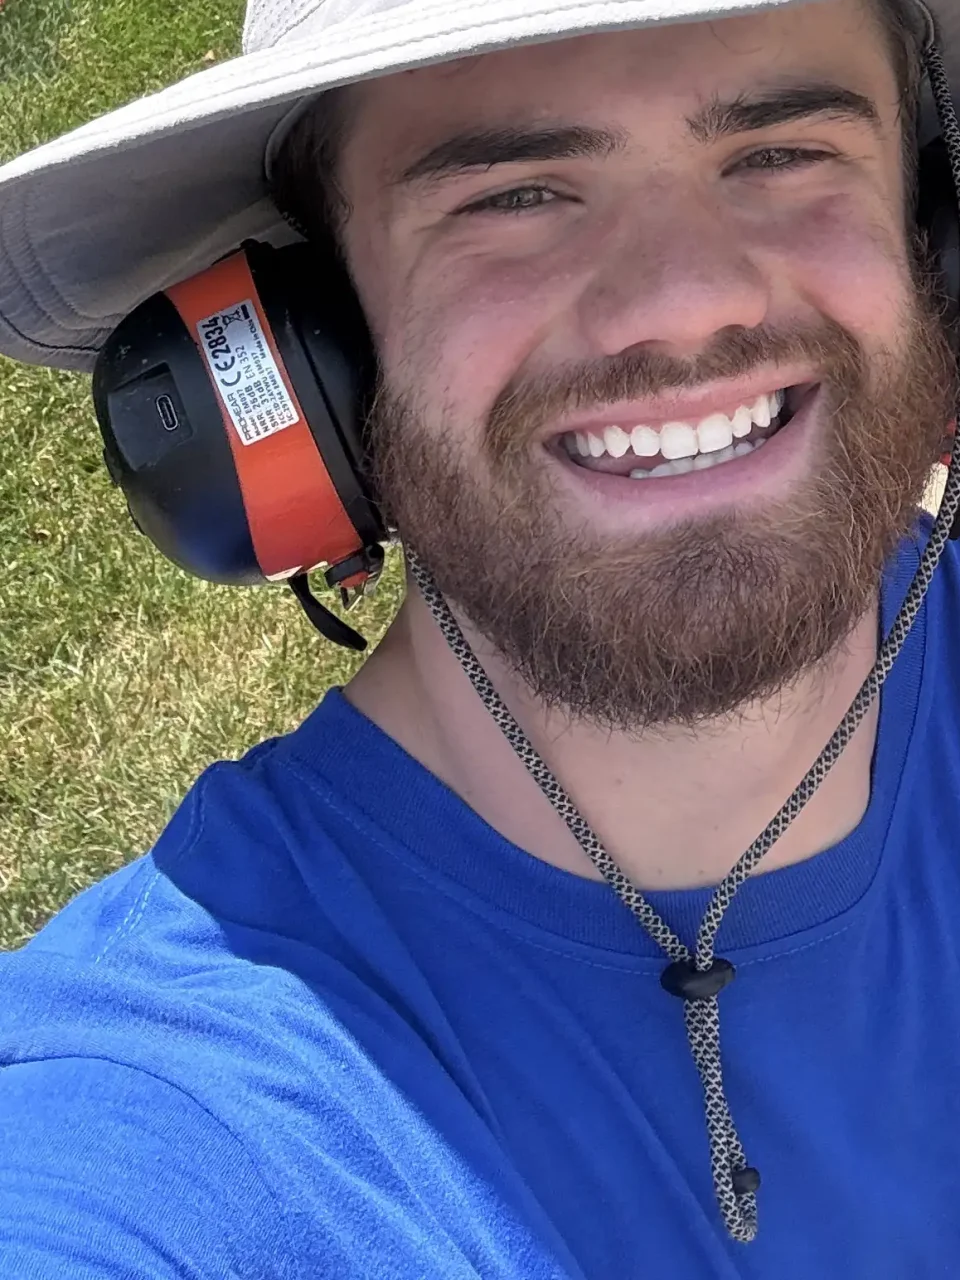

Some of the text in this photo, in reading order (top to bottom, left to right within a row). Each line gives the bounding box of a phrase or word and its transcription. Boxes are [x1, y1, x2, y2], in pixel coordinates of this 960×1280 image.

[201, 316, 232, 359] 2834
[235, 345, 256, 380] EN 352
[244, 384, 261, 410] 25dB
[253, 380, 270, 405] 31dB
